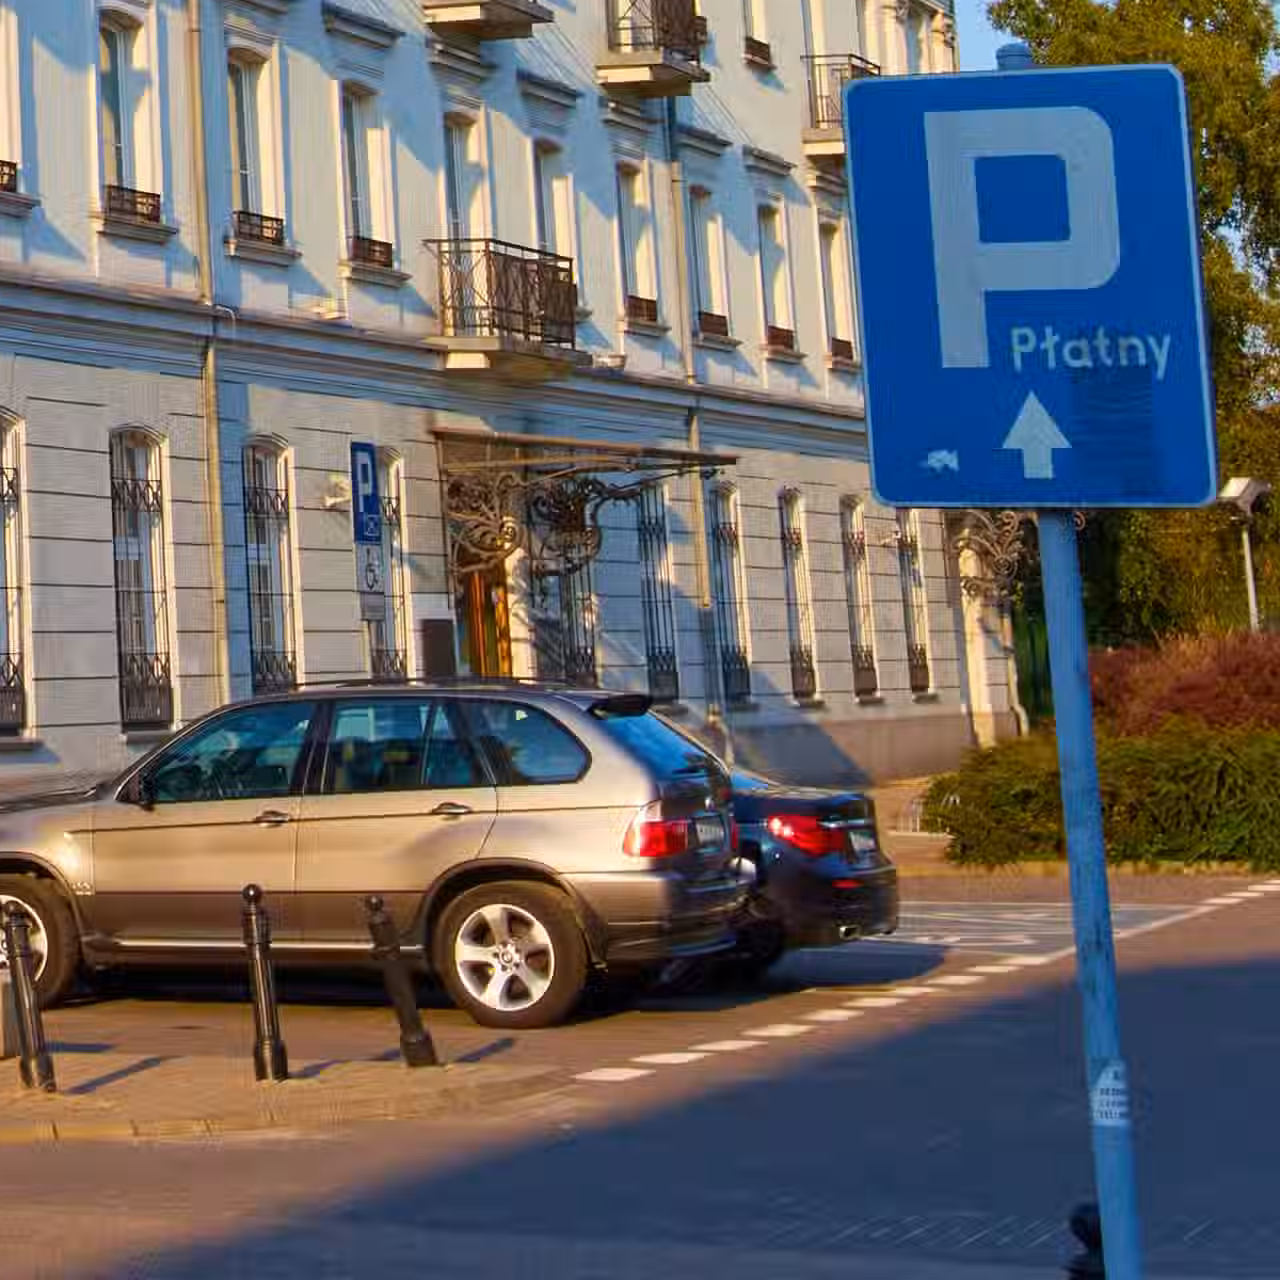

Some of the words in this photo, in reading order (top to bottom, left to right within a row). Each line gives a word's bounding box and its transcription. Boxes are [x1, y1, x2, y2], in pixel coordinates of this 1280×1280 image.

[923, 106, 1121, 369] P
[1009, 323, 1172, 380] Płatny
[356, 450, 373, 513] P
